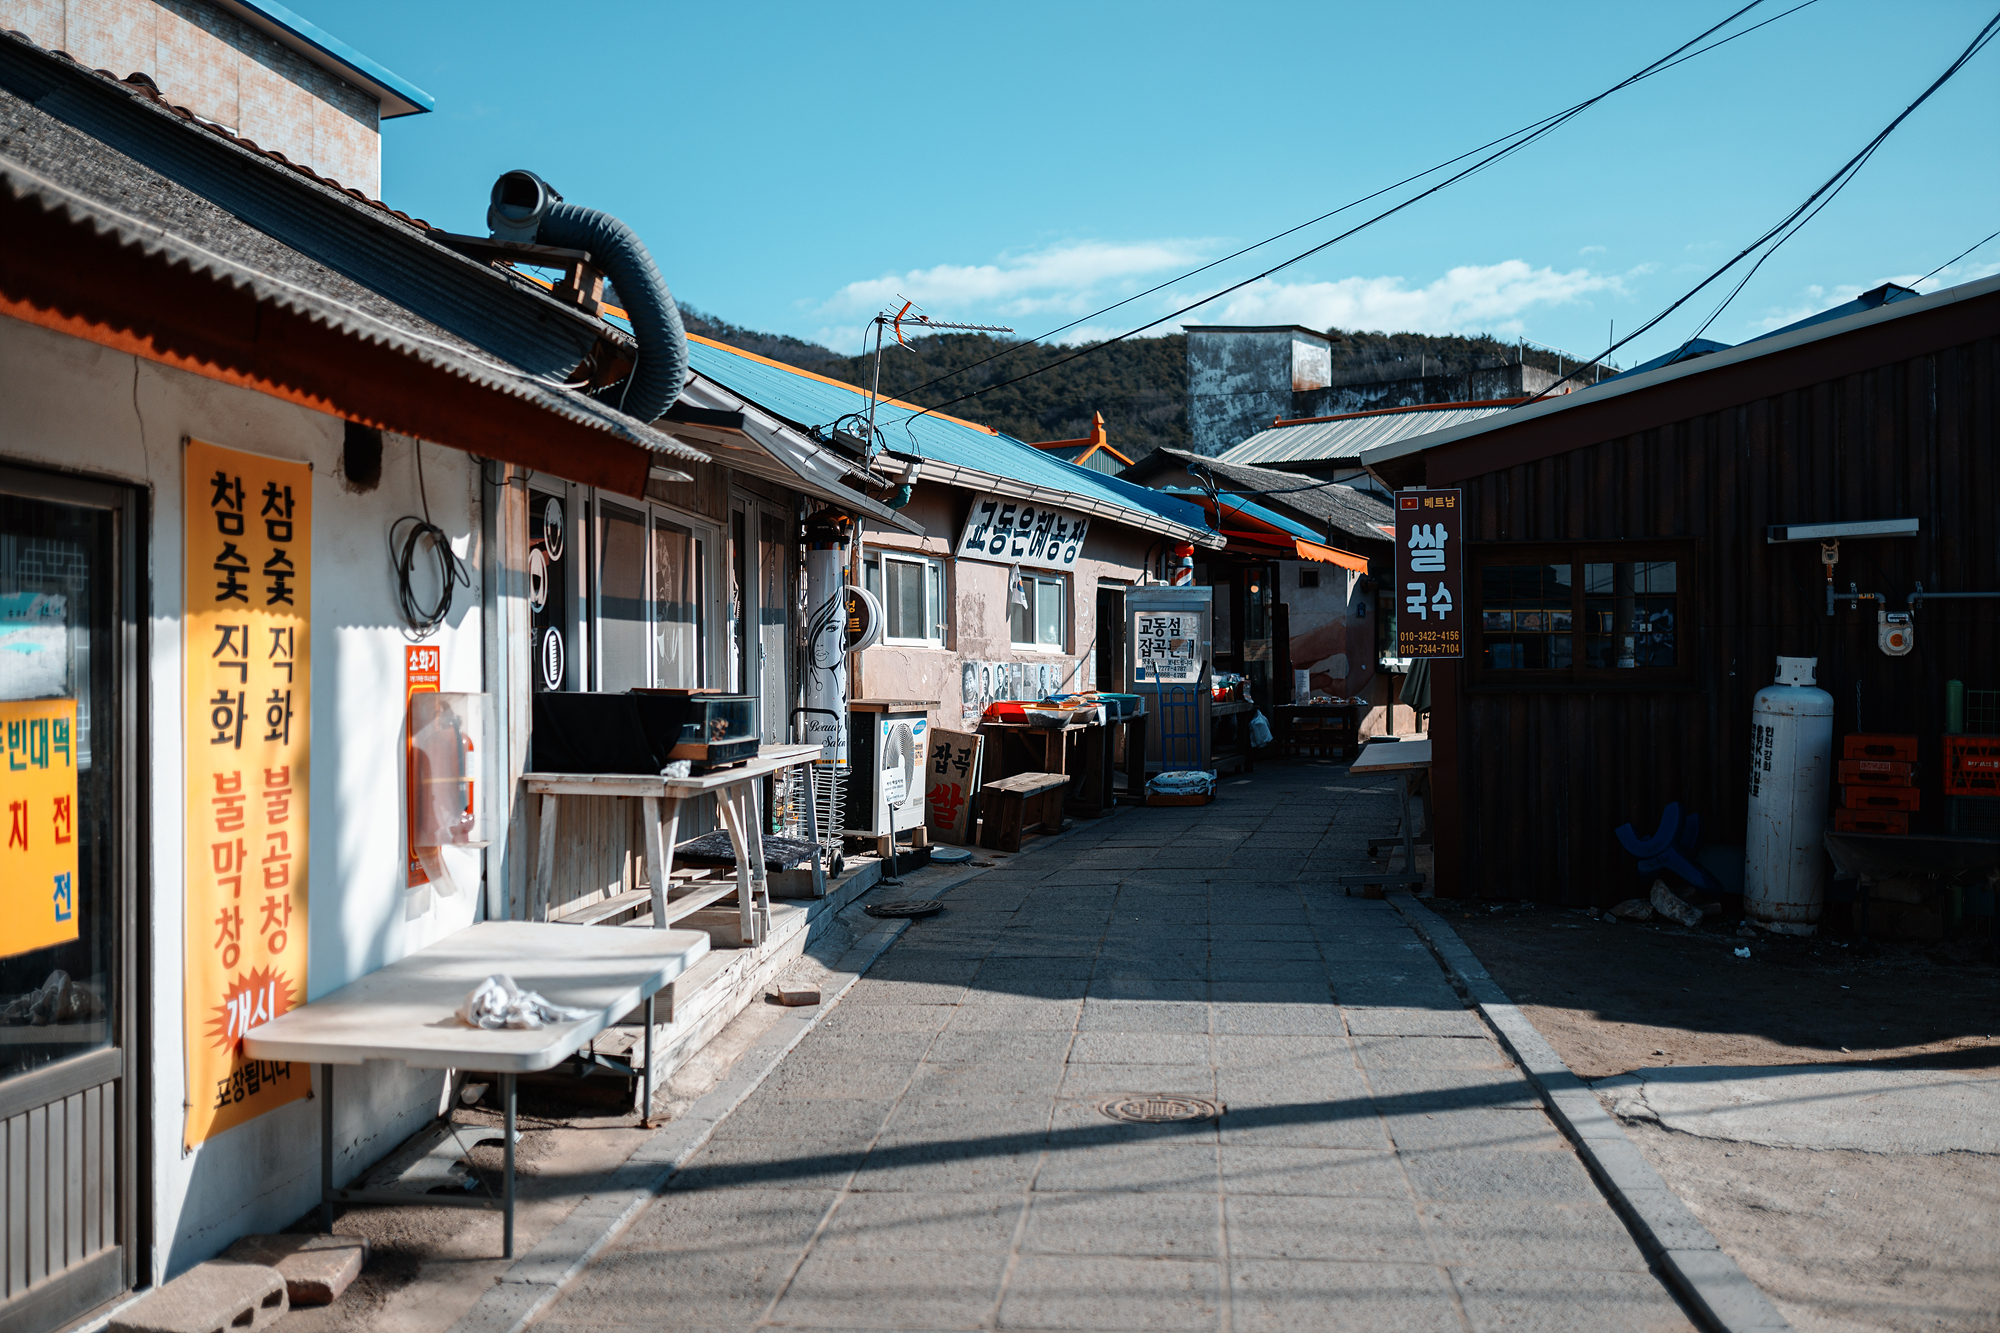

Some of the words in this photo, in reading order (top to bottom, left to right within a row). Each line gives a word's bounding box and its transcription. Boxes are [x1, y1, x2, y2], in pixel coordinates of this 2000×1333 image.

[1424, 496, 1456, 508] 베트남
[210, 471, 250, 604] 참숯
[261, 481, 295, 607] 참숯
[1408, 522, 1448, 572] 쌀
[1406, 581, 1453, 620] 국수
[1139, 617, 1181, 637] 교동섬
[1400, 630, 1460, 641] 010-3422-4156
[1400, 643, 1460, 654] 010-7344-7104
[263, 626, 293, 746] 직화
[409, 650, 439, 672] 소화기
[210, 624, 248, 750] 직화
[0, 717, 69, 772] 빈대떡
[809, 720, 842, 733] Beauy
[931, 742, 971, 778] 잡곡
[8, 800, 28, 852] 치
[52, 794, 71, 845] 전
[926, 783, 965, 830] 쌀
[210, 770, 247, 970] 불막창
[259, 765, 292, 956] 불곱창
[52, 872, 71, 923] 전
[226, 981, 275, 1038] 개시
